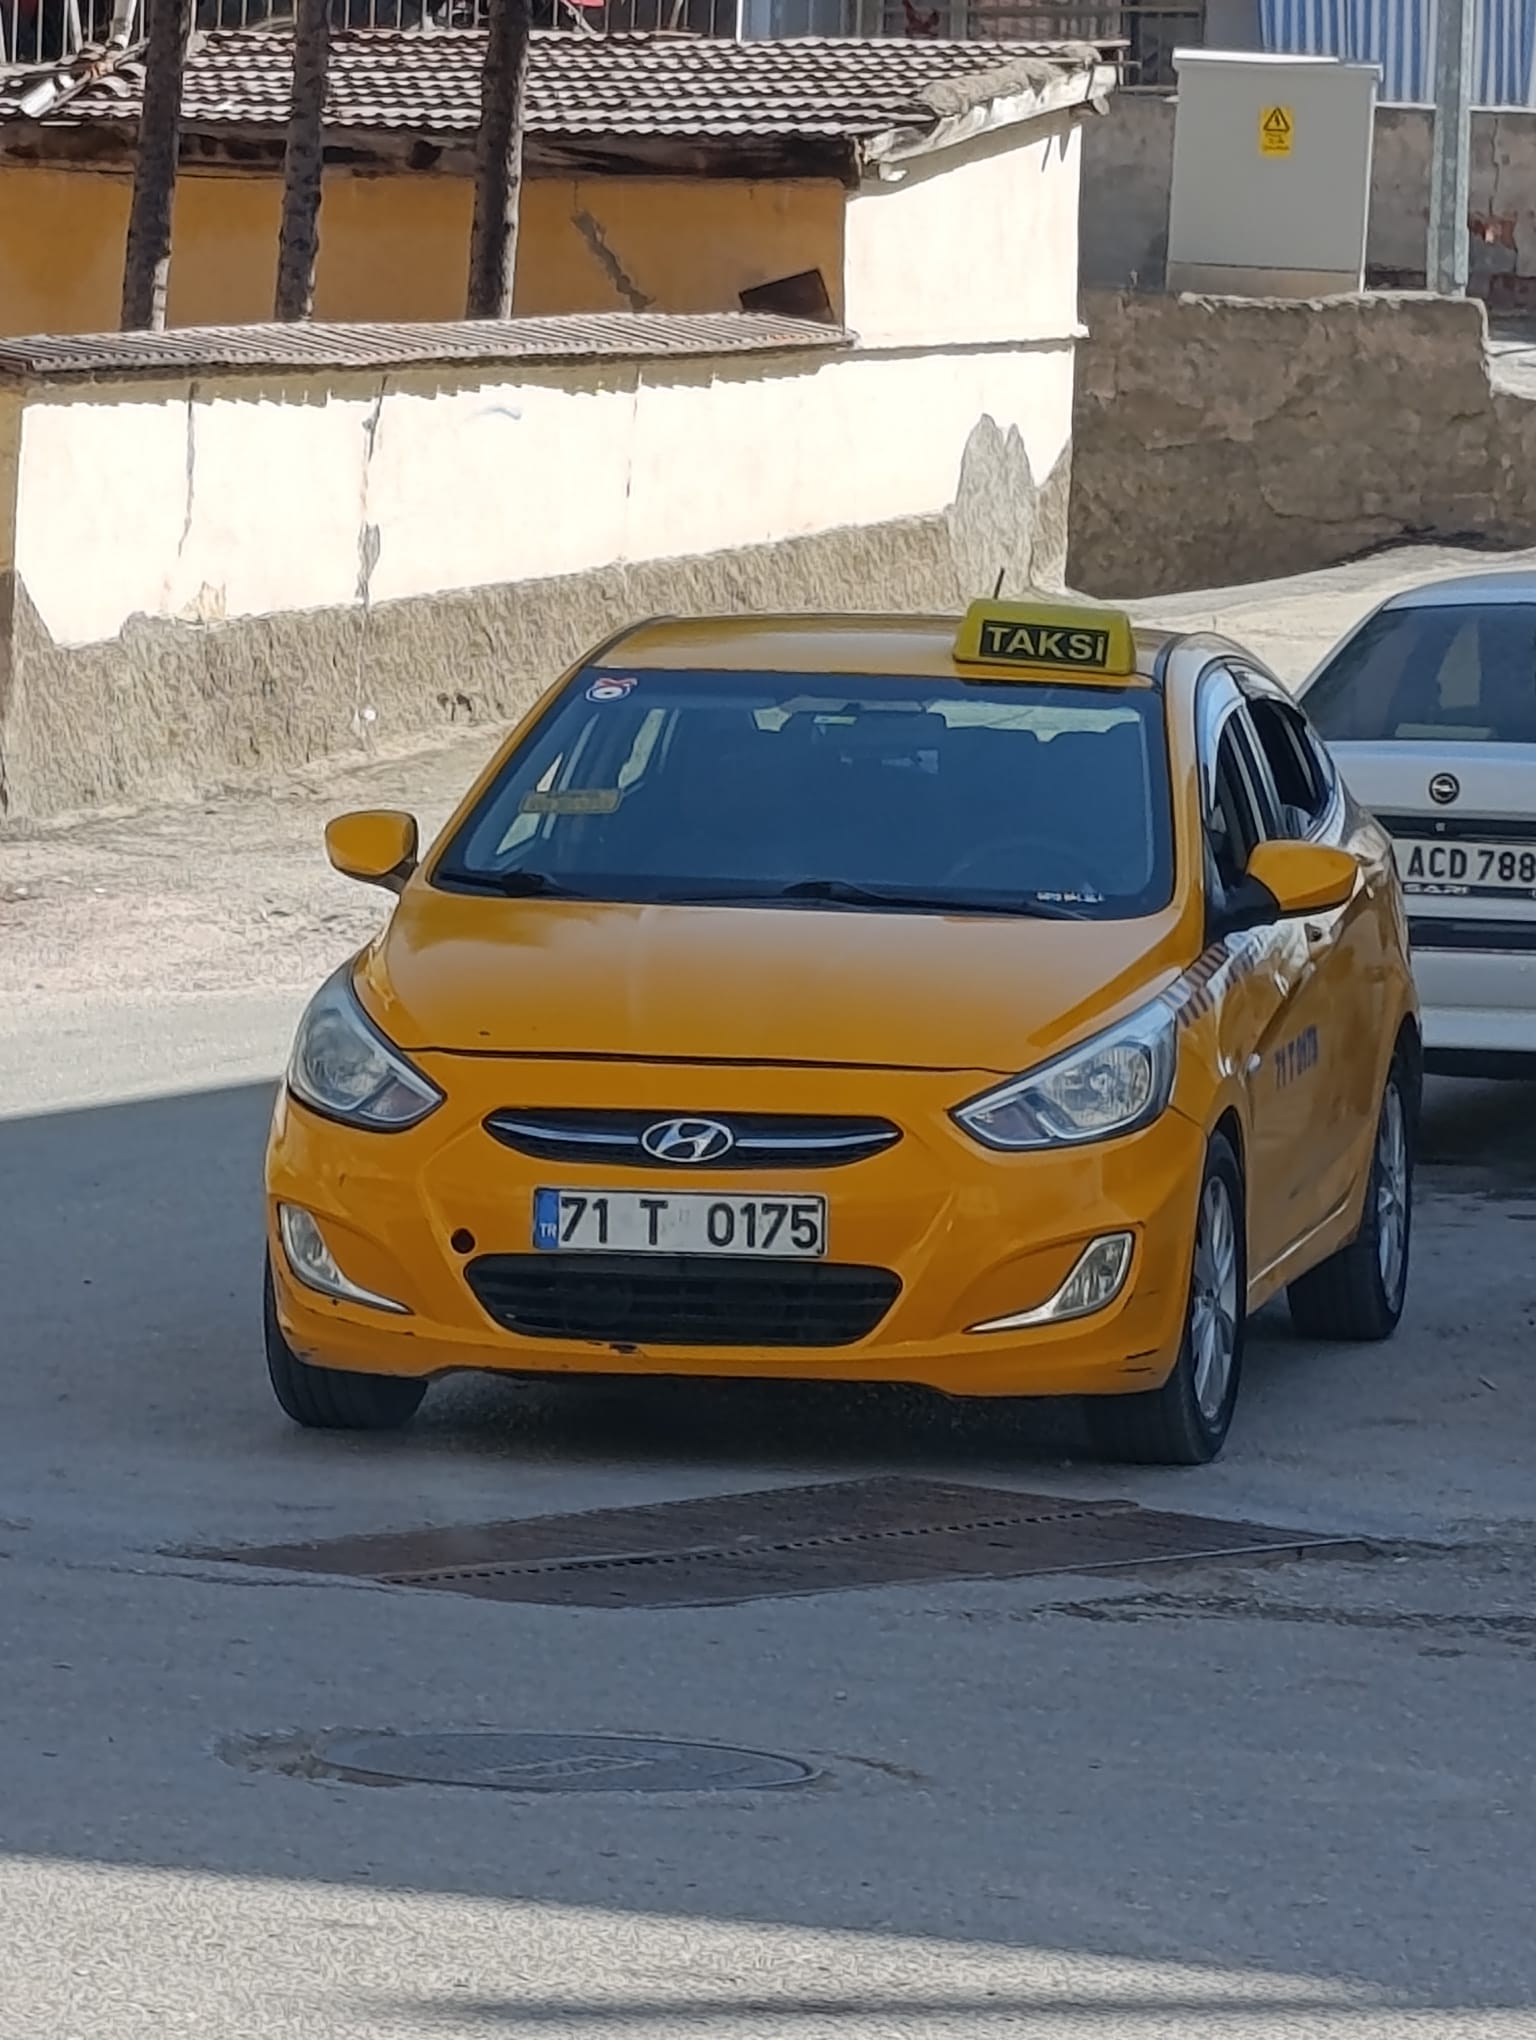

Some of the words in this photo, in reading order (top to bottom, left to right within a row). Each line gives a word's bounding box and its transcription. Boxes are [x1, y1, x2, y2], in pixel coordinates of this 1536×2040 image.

[1407, 846, 1467, 878] ACD
[1477, 850, 1536, 882] 788
[540, 1222, 557, 1238] TR
[560, 1197, 608, 1244] 71
[639, 1199, 669, 1245] T
[706, 1201, 819, 1249] 0175
